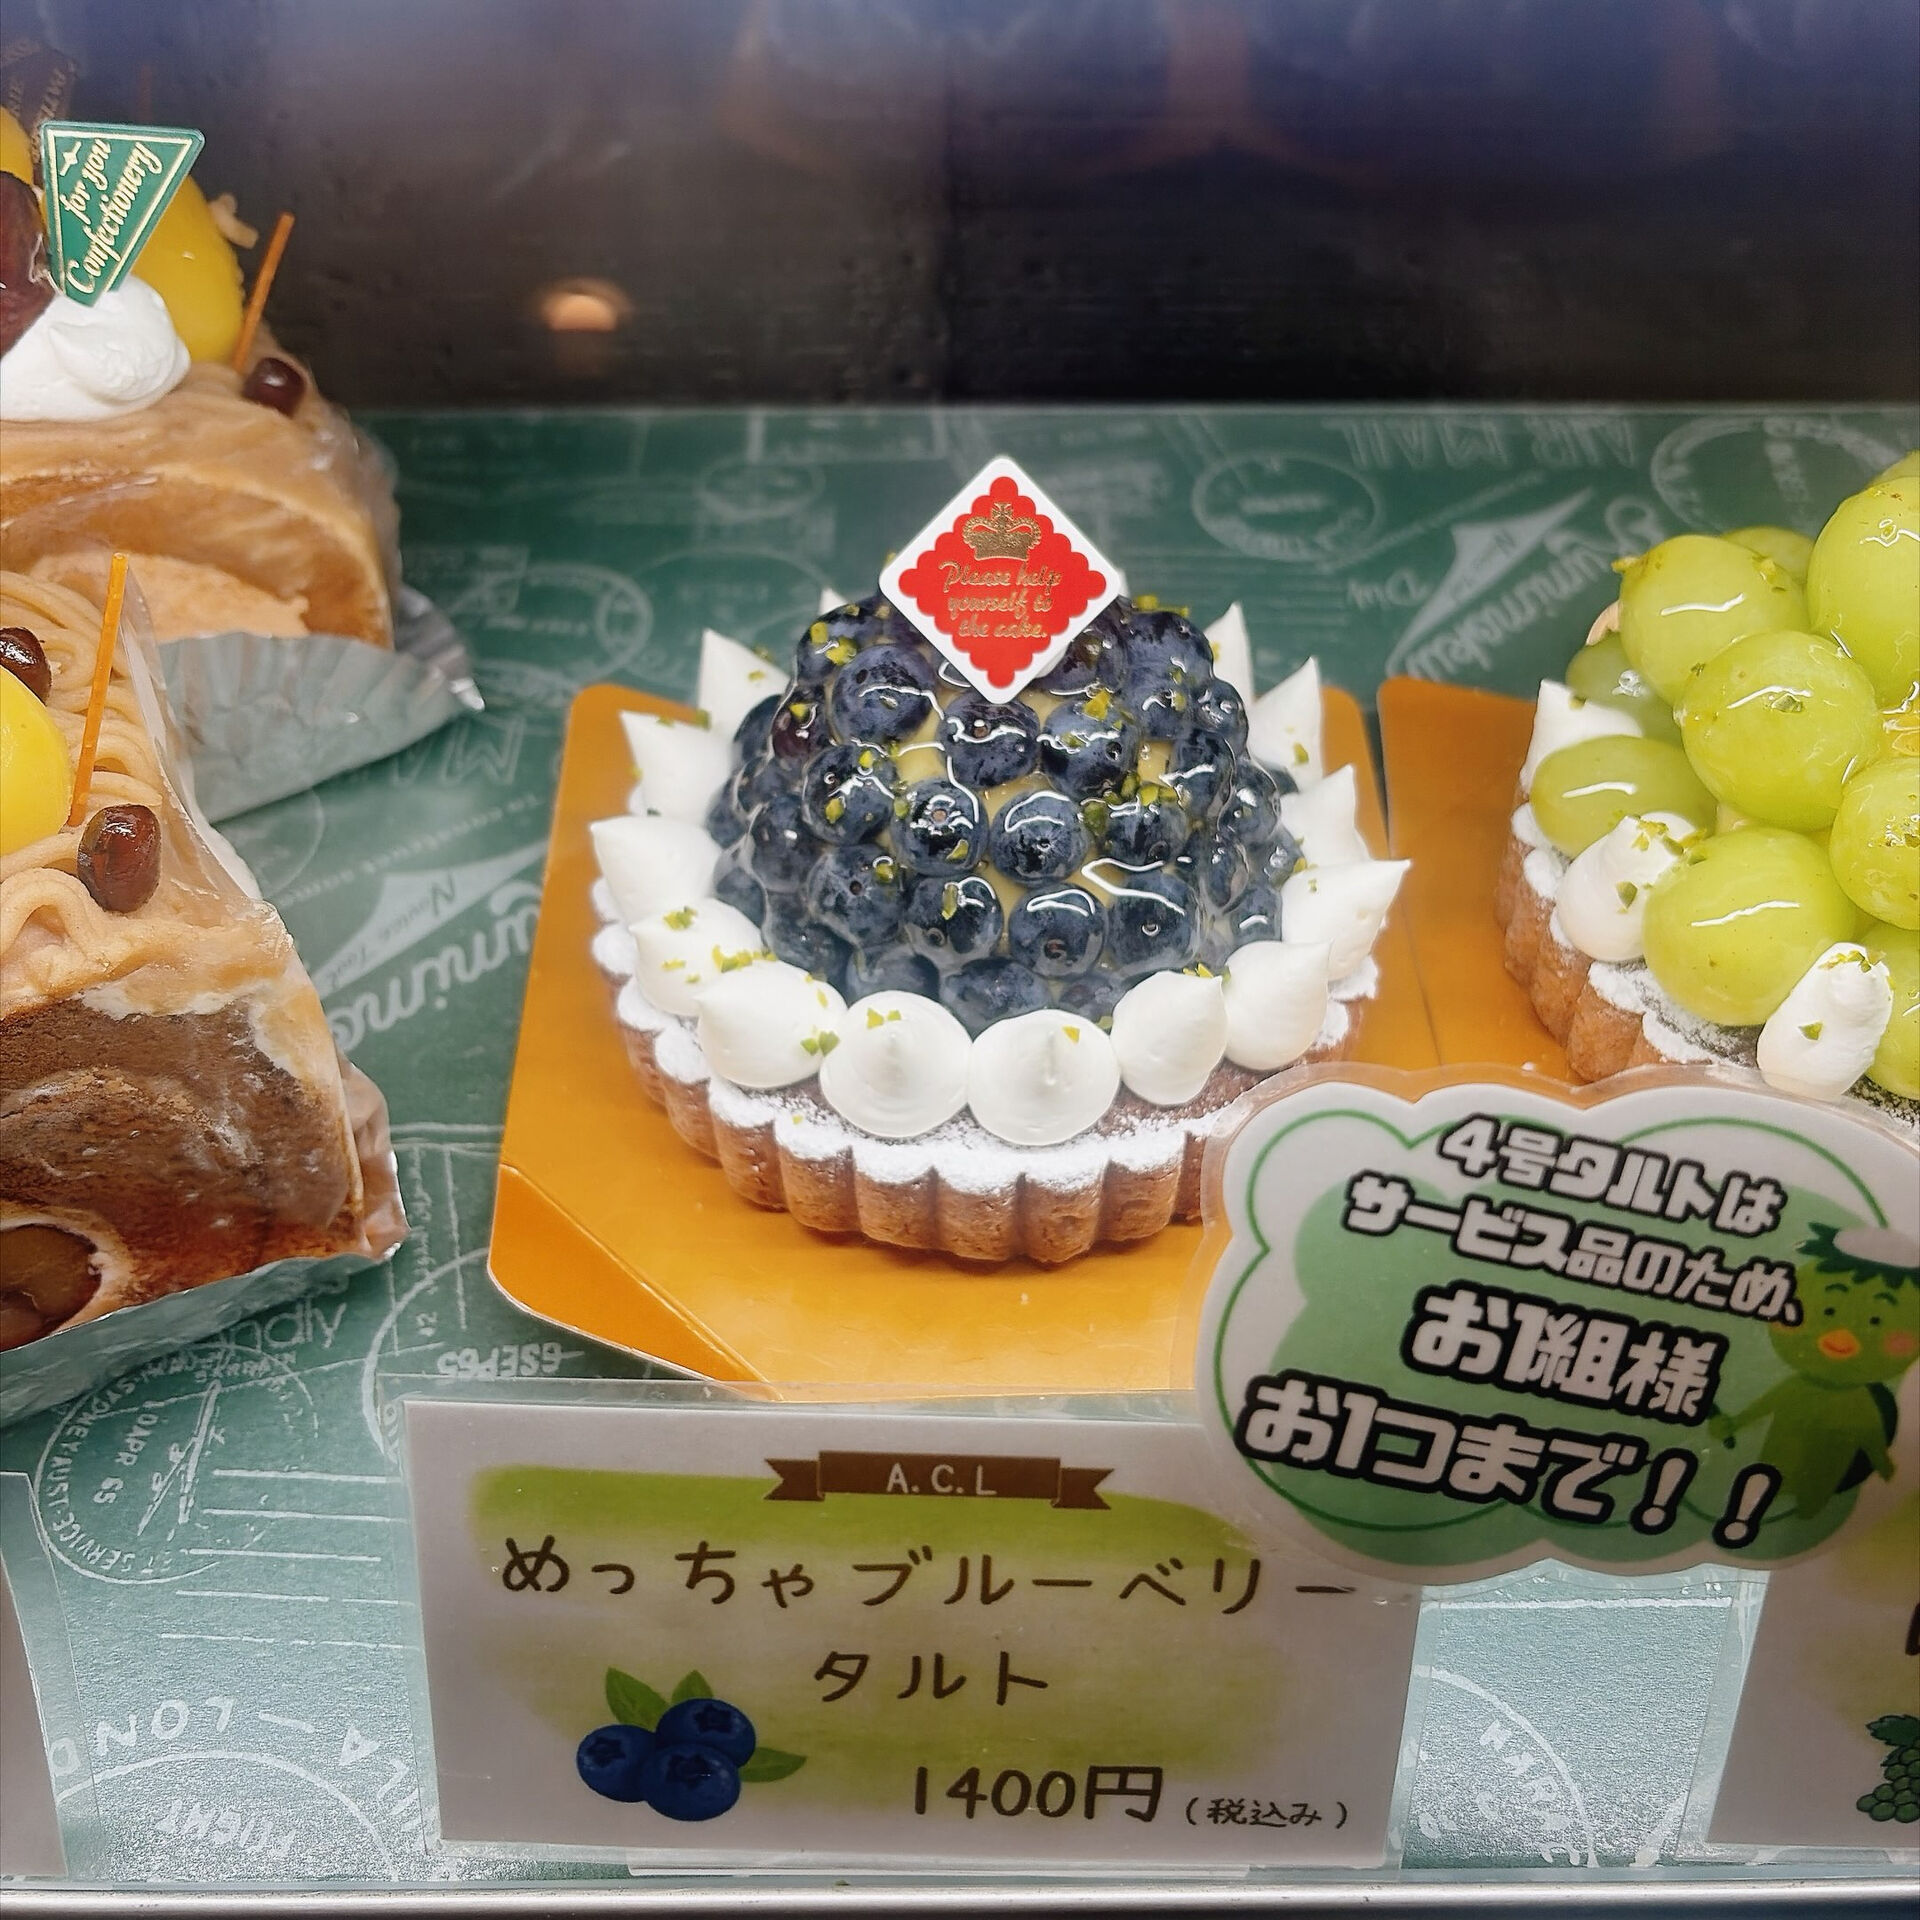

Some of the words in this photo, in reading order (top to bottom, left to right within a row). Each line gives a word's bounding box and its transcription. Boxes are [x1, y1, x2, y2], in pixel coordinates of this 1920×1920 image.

[60, 180, 92, 225] for
[82, 138, 112, 191] you
[66, 141, 163, 293] Confectionery
[938, 561, 1011, 593] Please
[1017, 560, 1061, 596] help
[948, 588, 1028, 621] yourself
[1033, 594, 1054, 612] to
[958, 614, 989, 637] the
[993, 617, 1048, 639] cake.
[1437, 1112, 1788, 1238] 4号タルトは
[1342, 1170, 1805, 1327] サービス品のため、
[1402, 1280, 1729, 1426] お1組様
[887, 1462, 997, 1496] A.C.L
[1235, 1369, 1782, 1549] お1つまで！！
[501, 1534, 1355, 1615] めっちゃブルーベリー
[813, 1650, 1049, 1706] タルト
[914, 1765, 1163, 1823] 1400円
